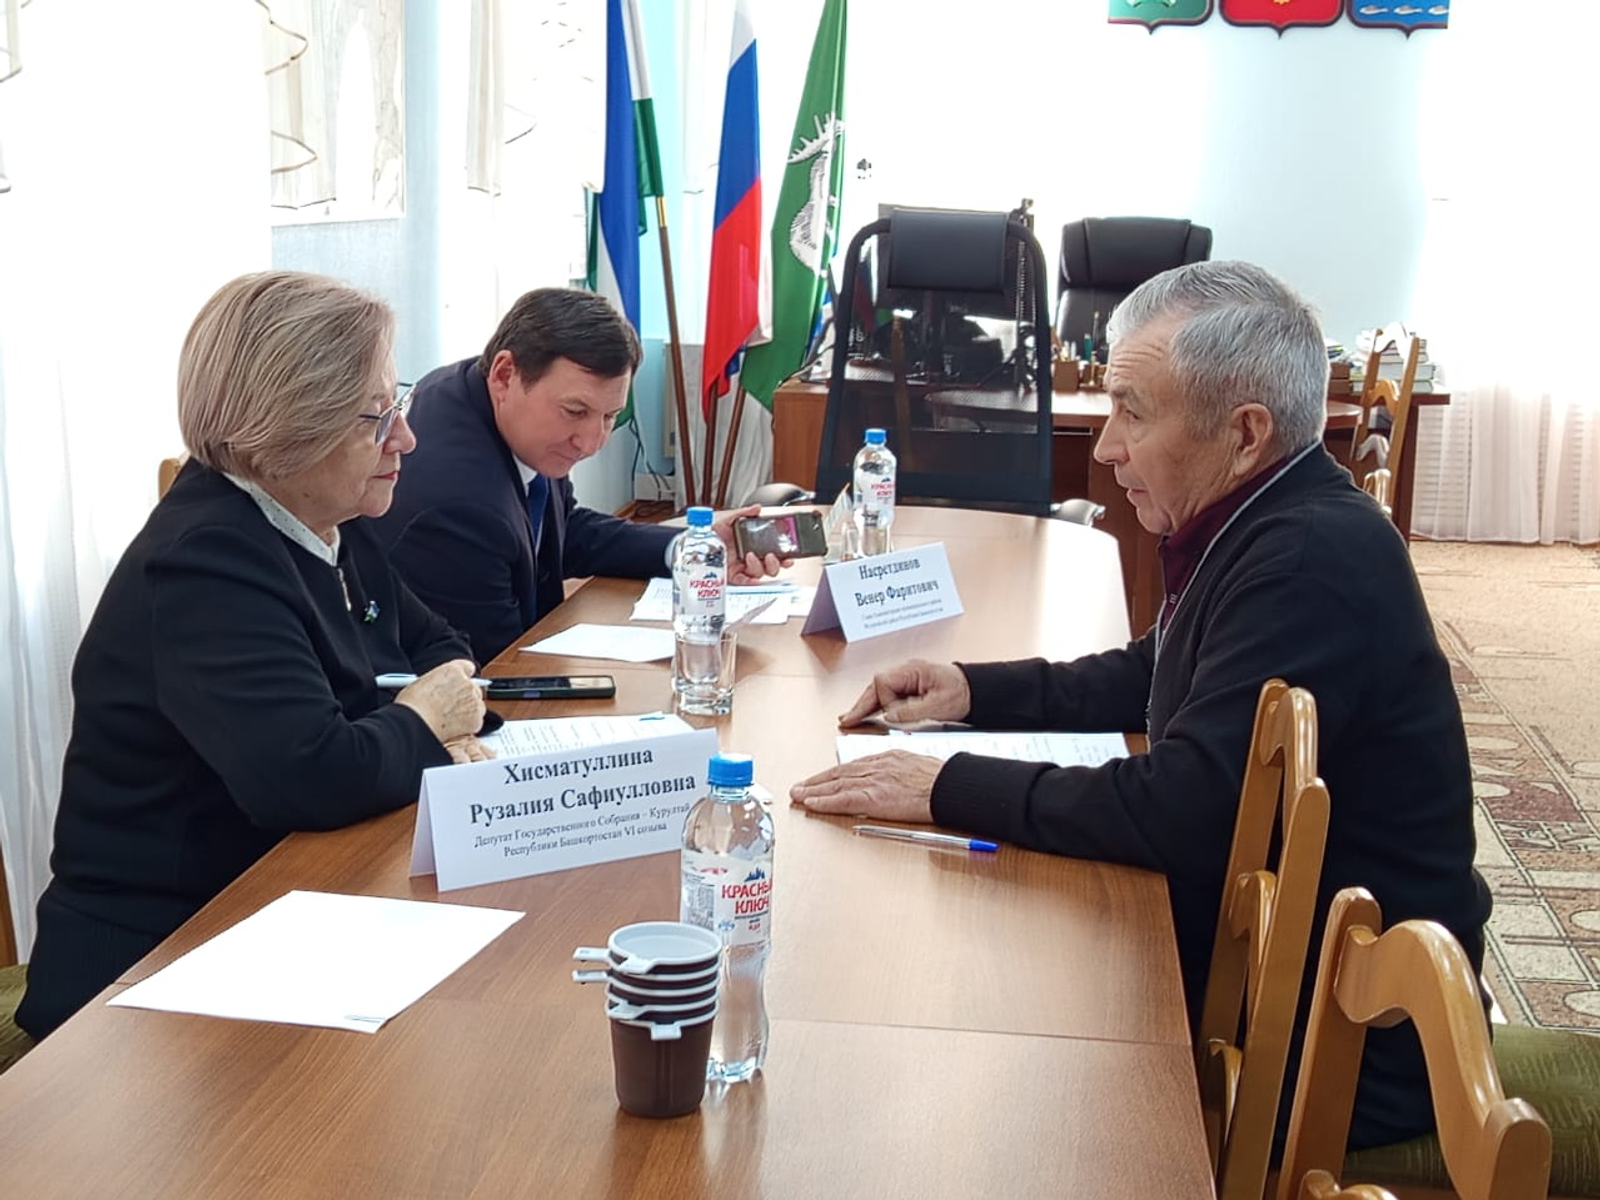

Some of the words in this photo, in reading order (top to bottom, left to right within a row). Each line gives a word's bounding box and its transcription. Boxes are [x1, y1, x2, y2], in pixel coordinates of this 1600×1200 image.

[858, 558, 921, 580] Насретдинов
[854, 591, 885, 607] Венер
[885, 579, 940, 602] Фаритович
[504, 749, 654, 785] Хисматуллина
[469, 796, 555, 828] Рузалия
[560, 775, 697, 810] Сафиулловна
[473, 833, 512, 848] Депутат
[514, 820, 597, 840] Государственного
[597, 812, 641, 826] Собрания
[649, 802, 691, 820] Курултай
[503, 841, 558, 858] Республики
[559, 830, 623, 847] Башкортостан
[624, 825, 635, 836] VI
[735, 896, 770, 914] КЛЮЧ
